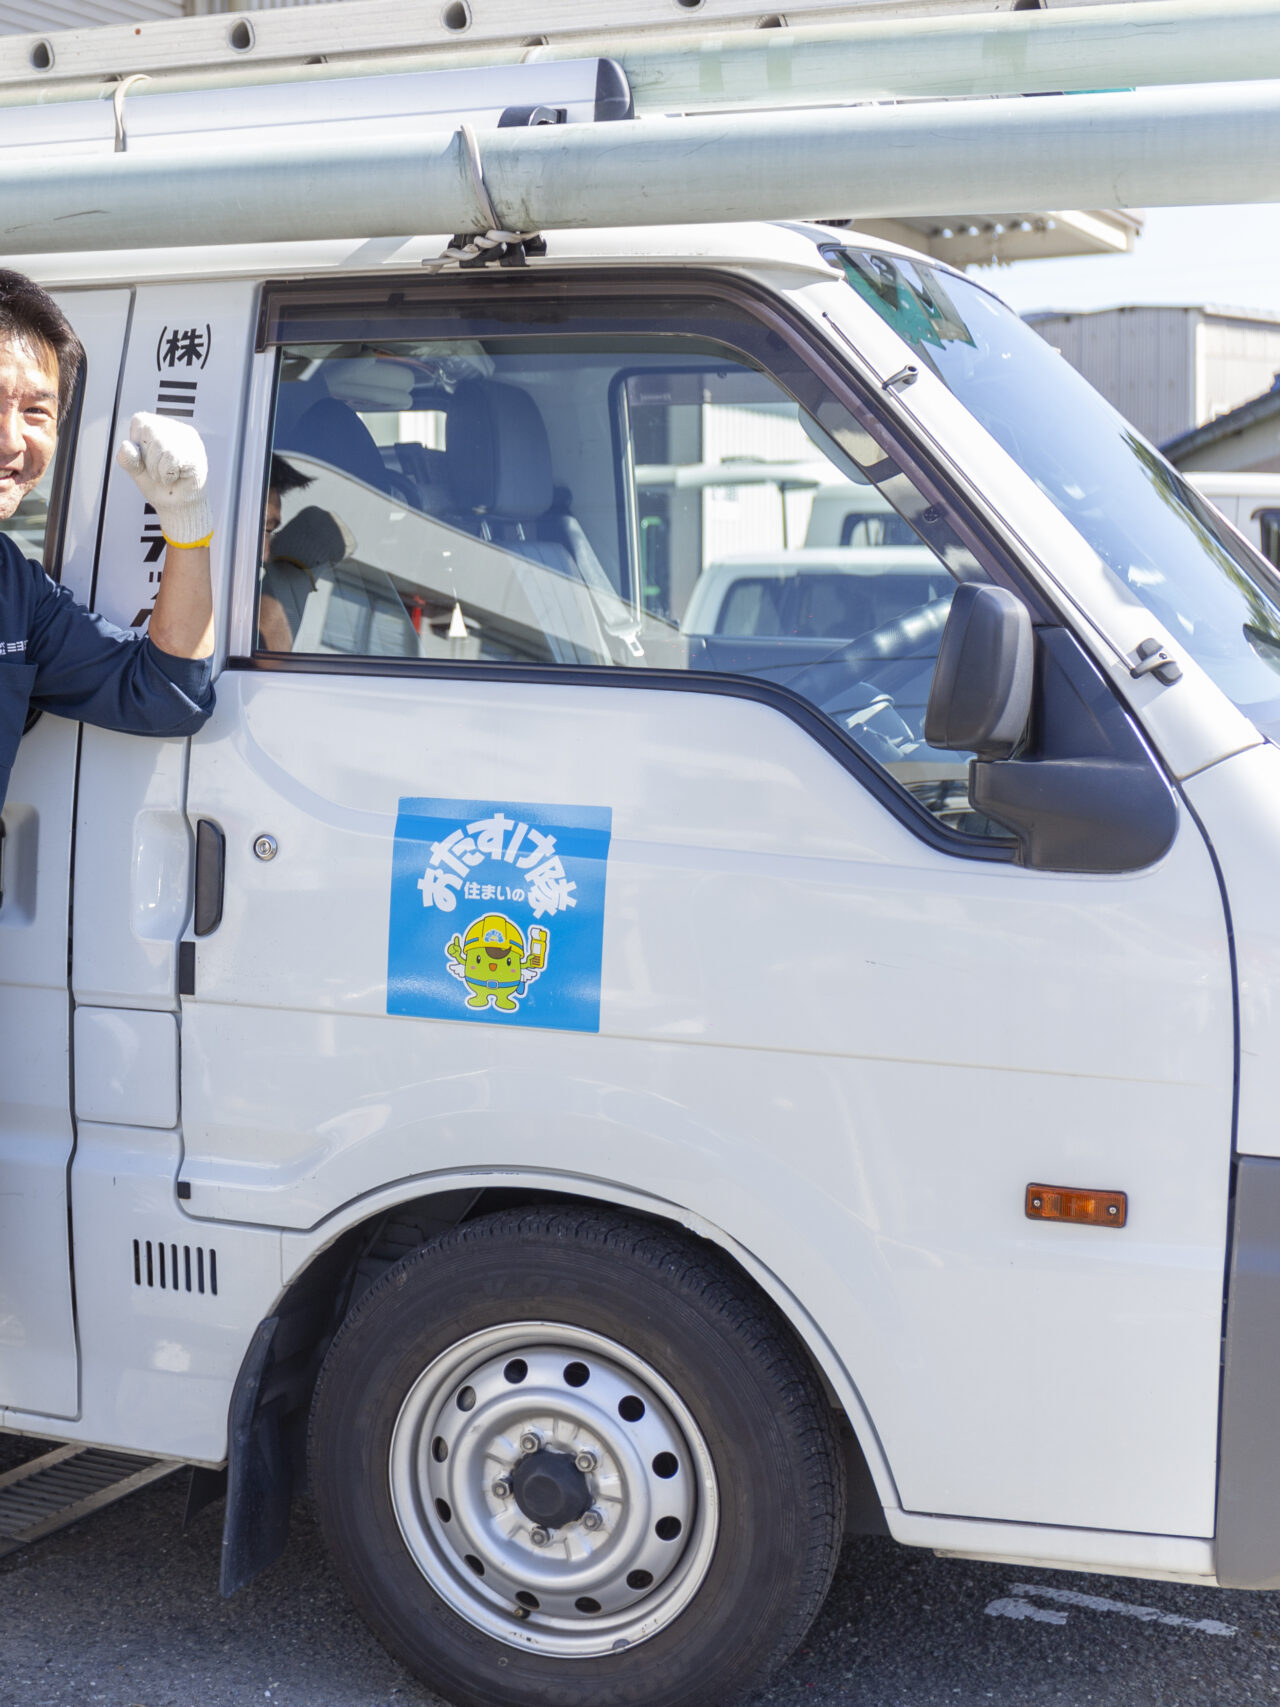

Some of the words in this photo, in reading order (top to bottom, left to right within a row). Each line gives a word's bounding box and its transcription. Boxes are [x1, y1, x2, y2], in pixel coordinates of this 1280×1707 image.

[417, 813, 577, 919] おたすけ隊
[464, 881, 525, 902] 住まいの
